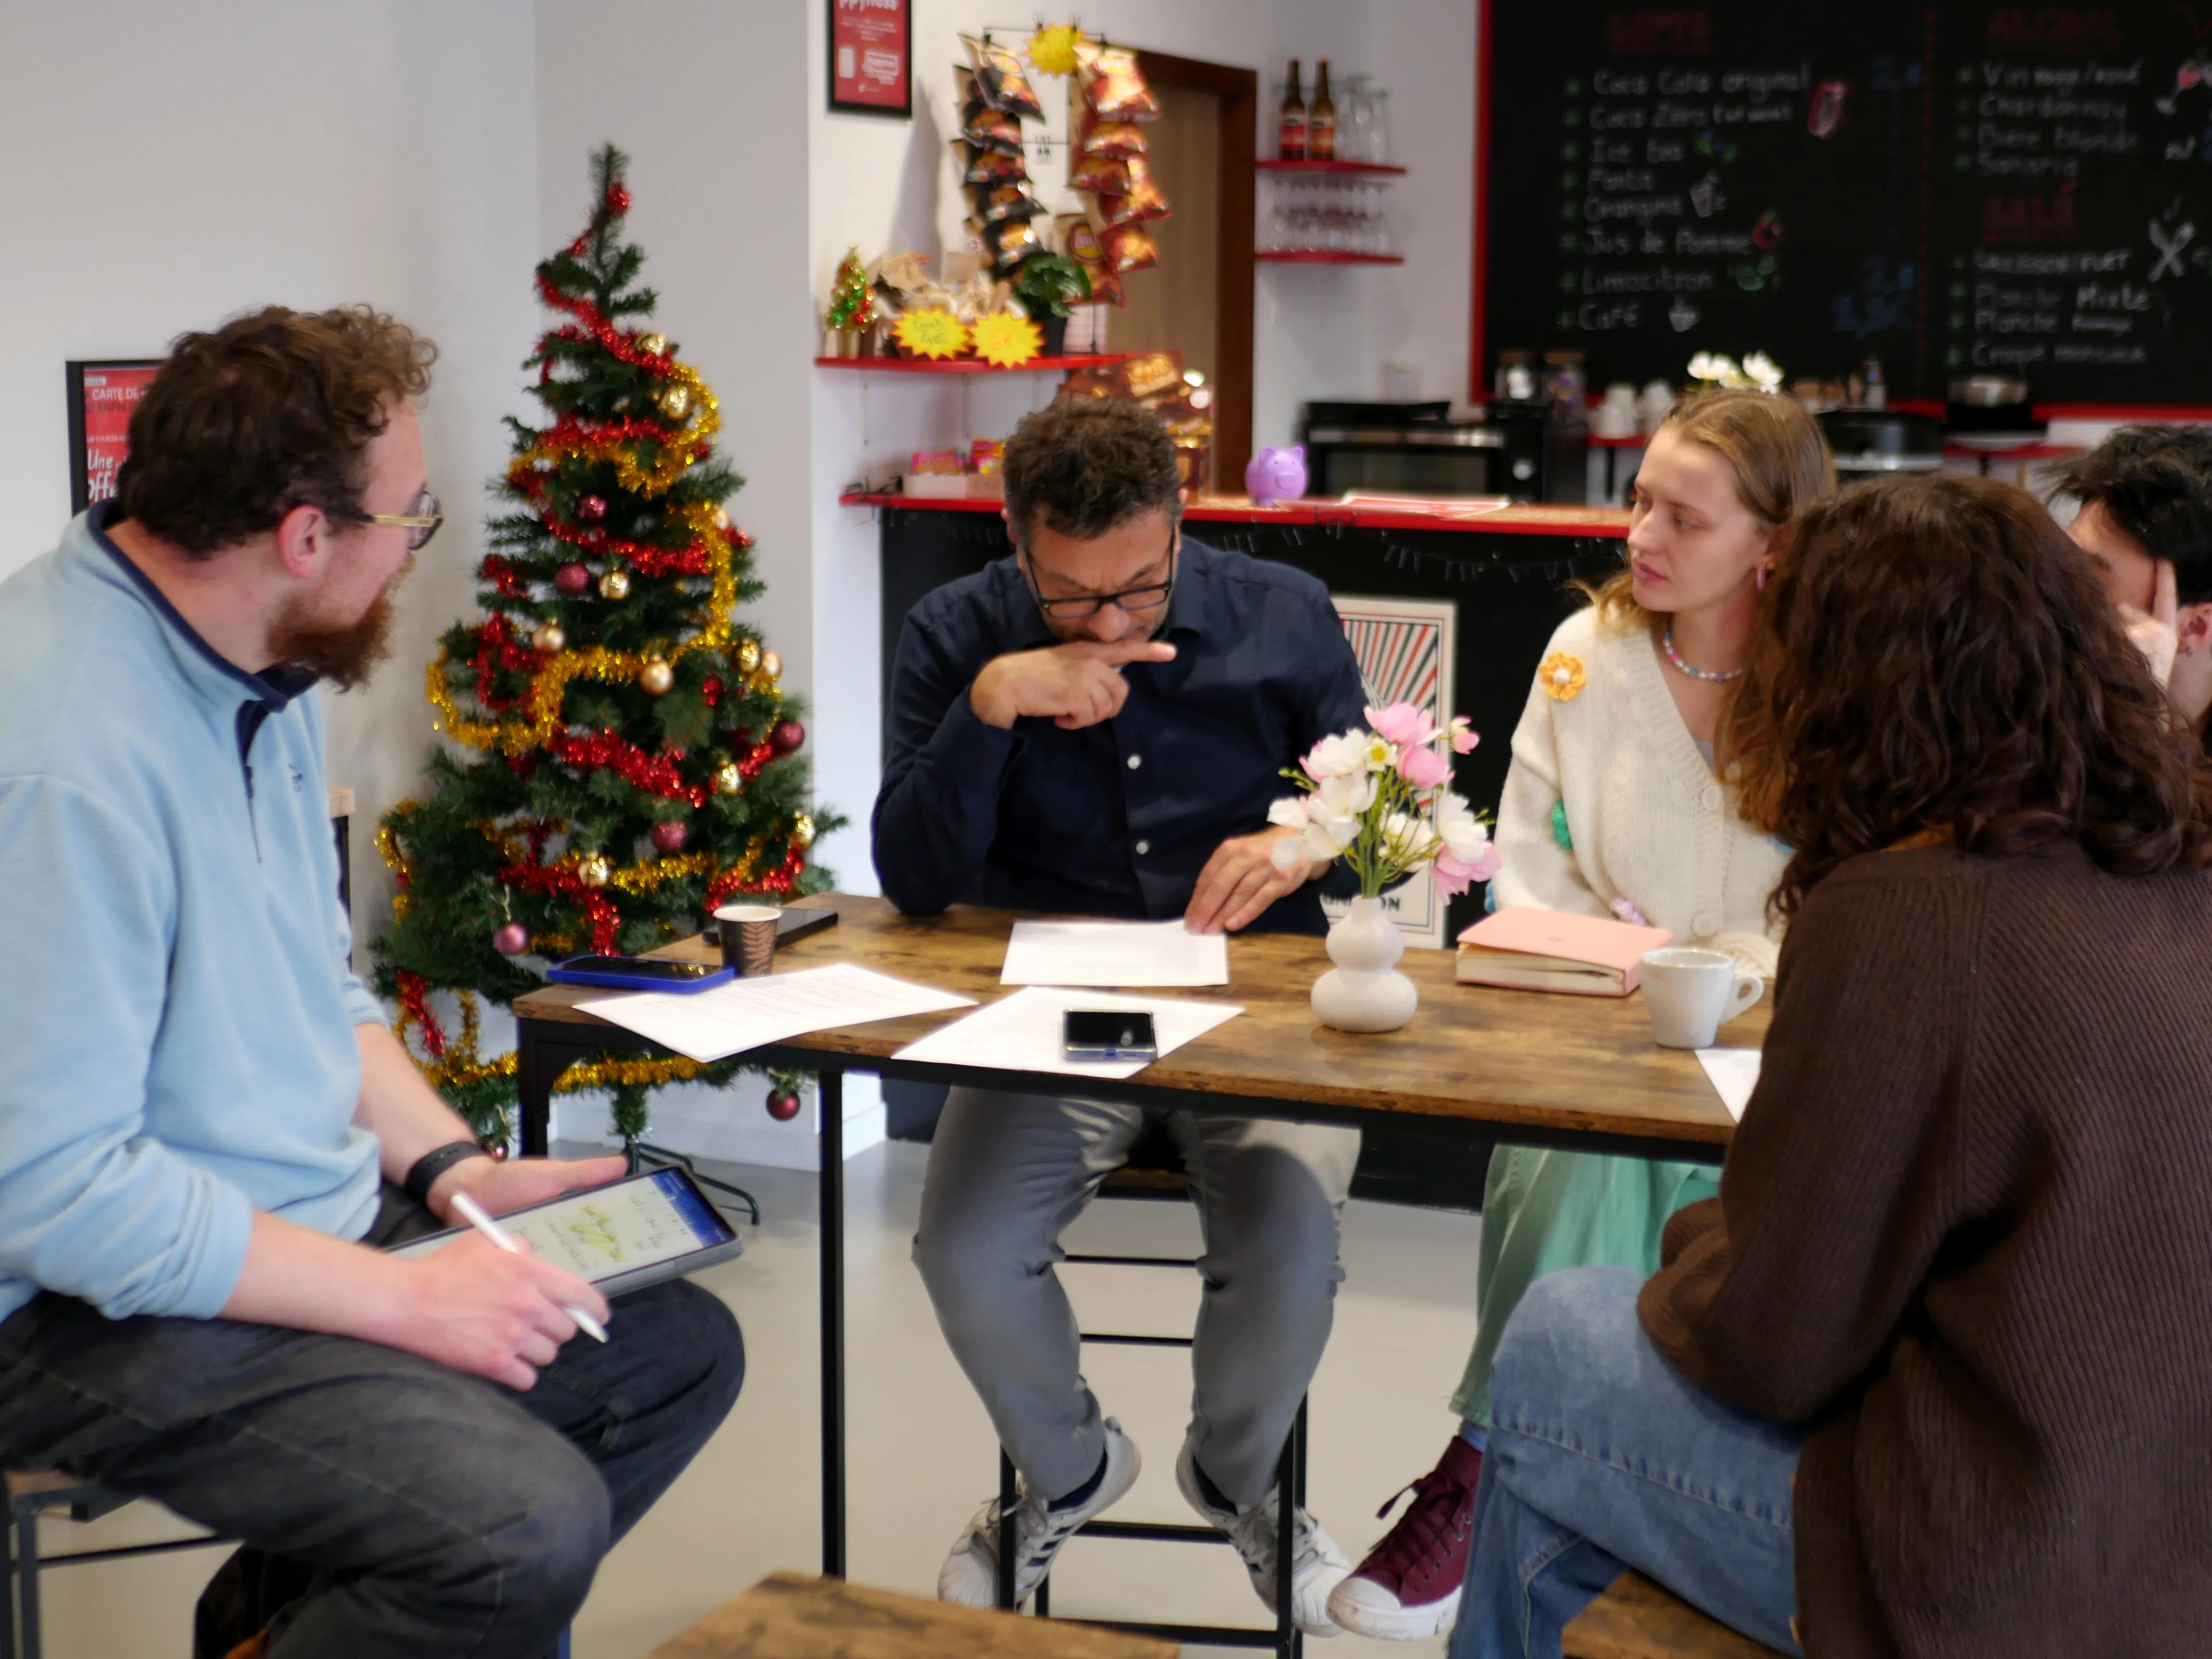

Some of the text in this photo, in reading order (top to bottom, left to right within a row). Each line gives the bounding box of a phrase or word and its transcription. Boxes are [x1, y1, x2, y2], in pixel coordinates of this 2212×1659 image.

[92, 387, 123, 402] CARTE
[126, 386, 139, 400] DE
[87, 449, 113, 471] Une
